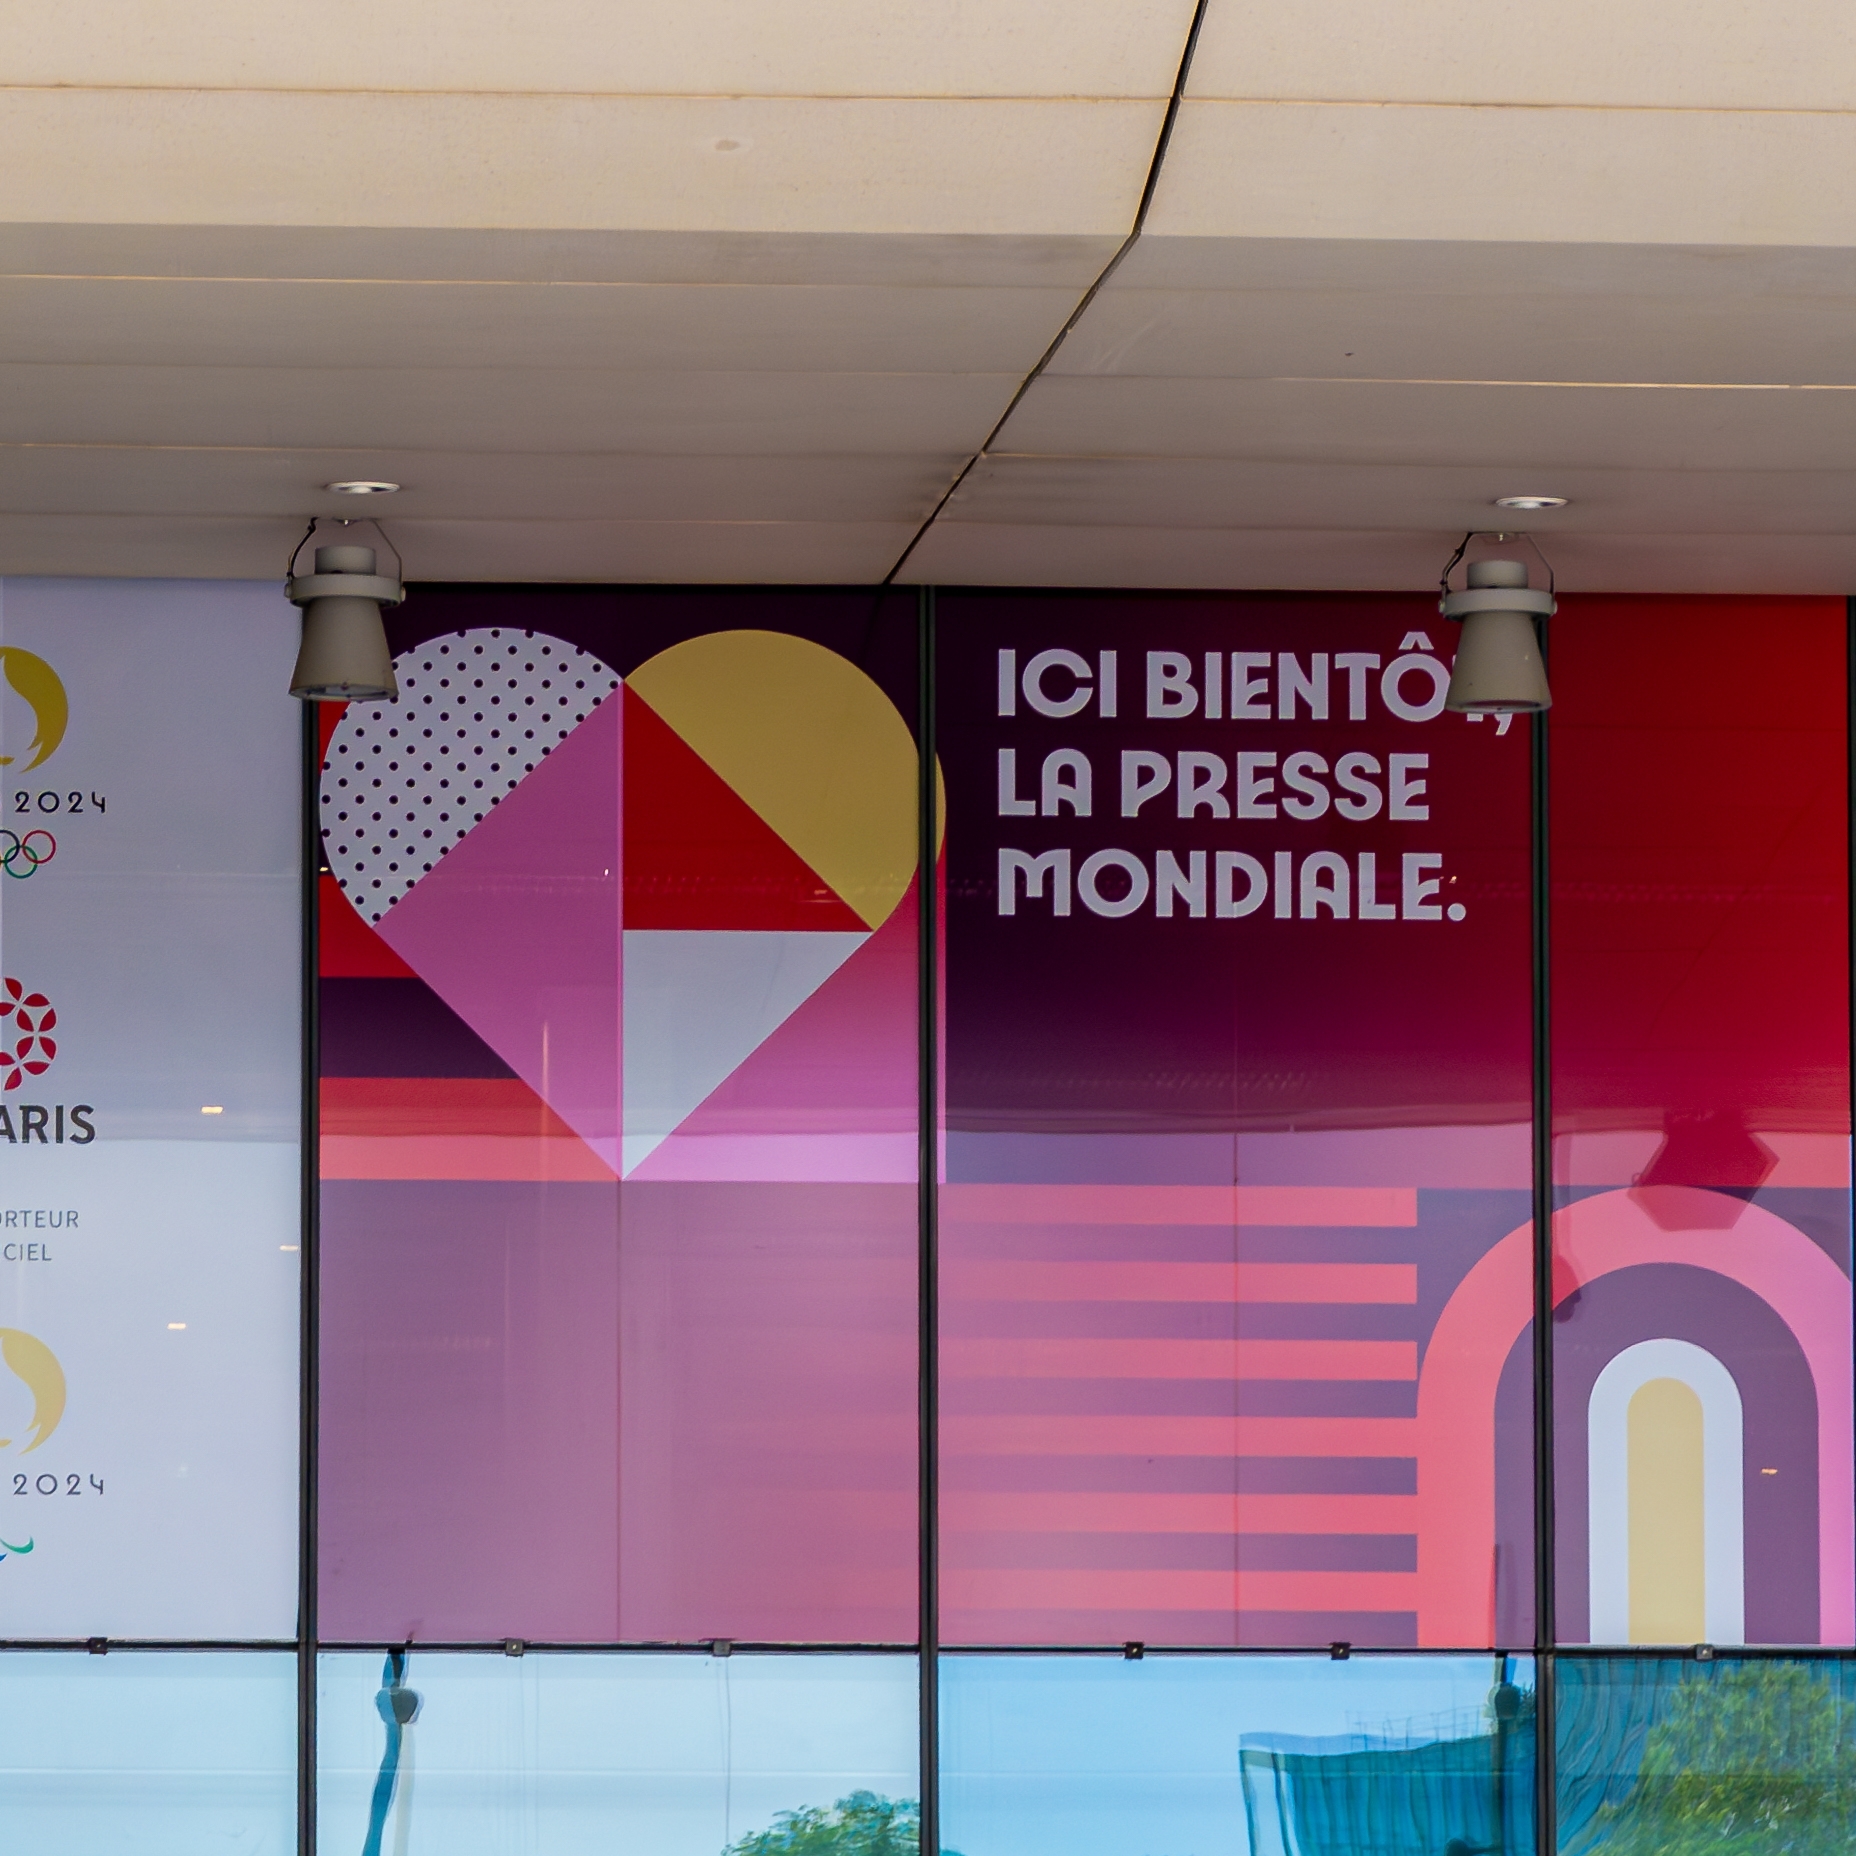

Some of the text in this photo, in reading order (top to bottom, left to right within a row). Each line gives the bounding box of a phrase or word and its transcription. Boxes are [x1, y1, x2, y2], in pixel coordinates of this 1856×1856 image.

[997, 631, 1514, 736] ICI BIENTÔ,
[15, 790, 108, 814] 2024
[997, 748, 1430, 821] LA PRESSE
[997, 847, 1467, 922] MONDIALE.
[12, 1471, 107, 1496] 2024
